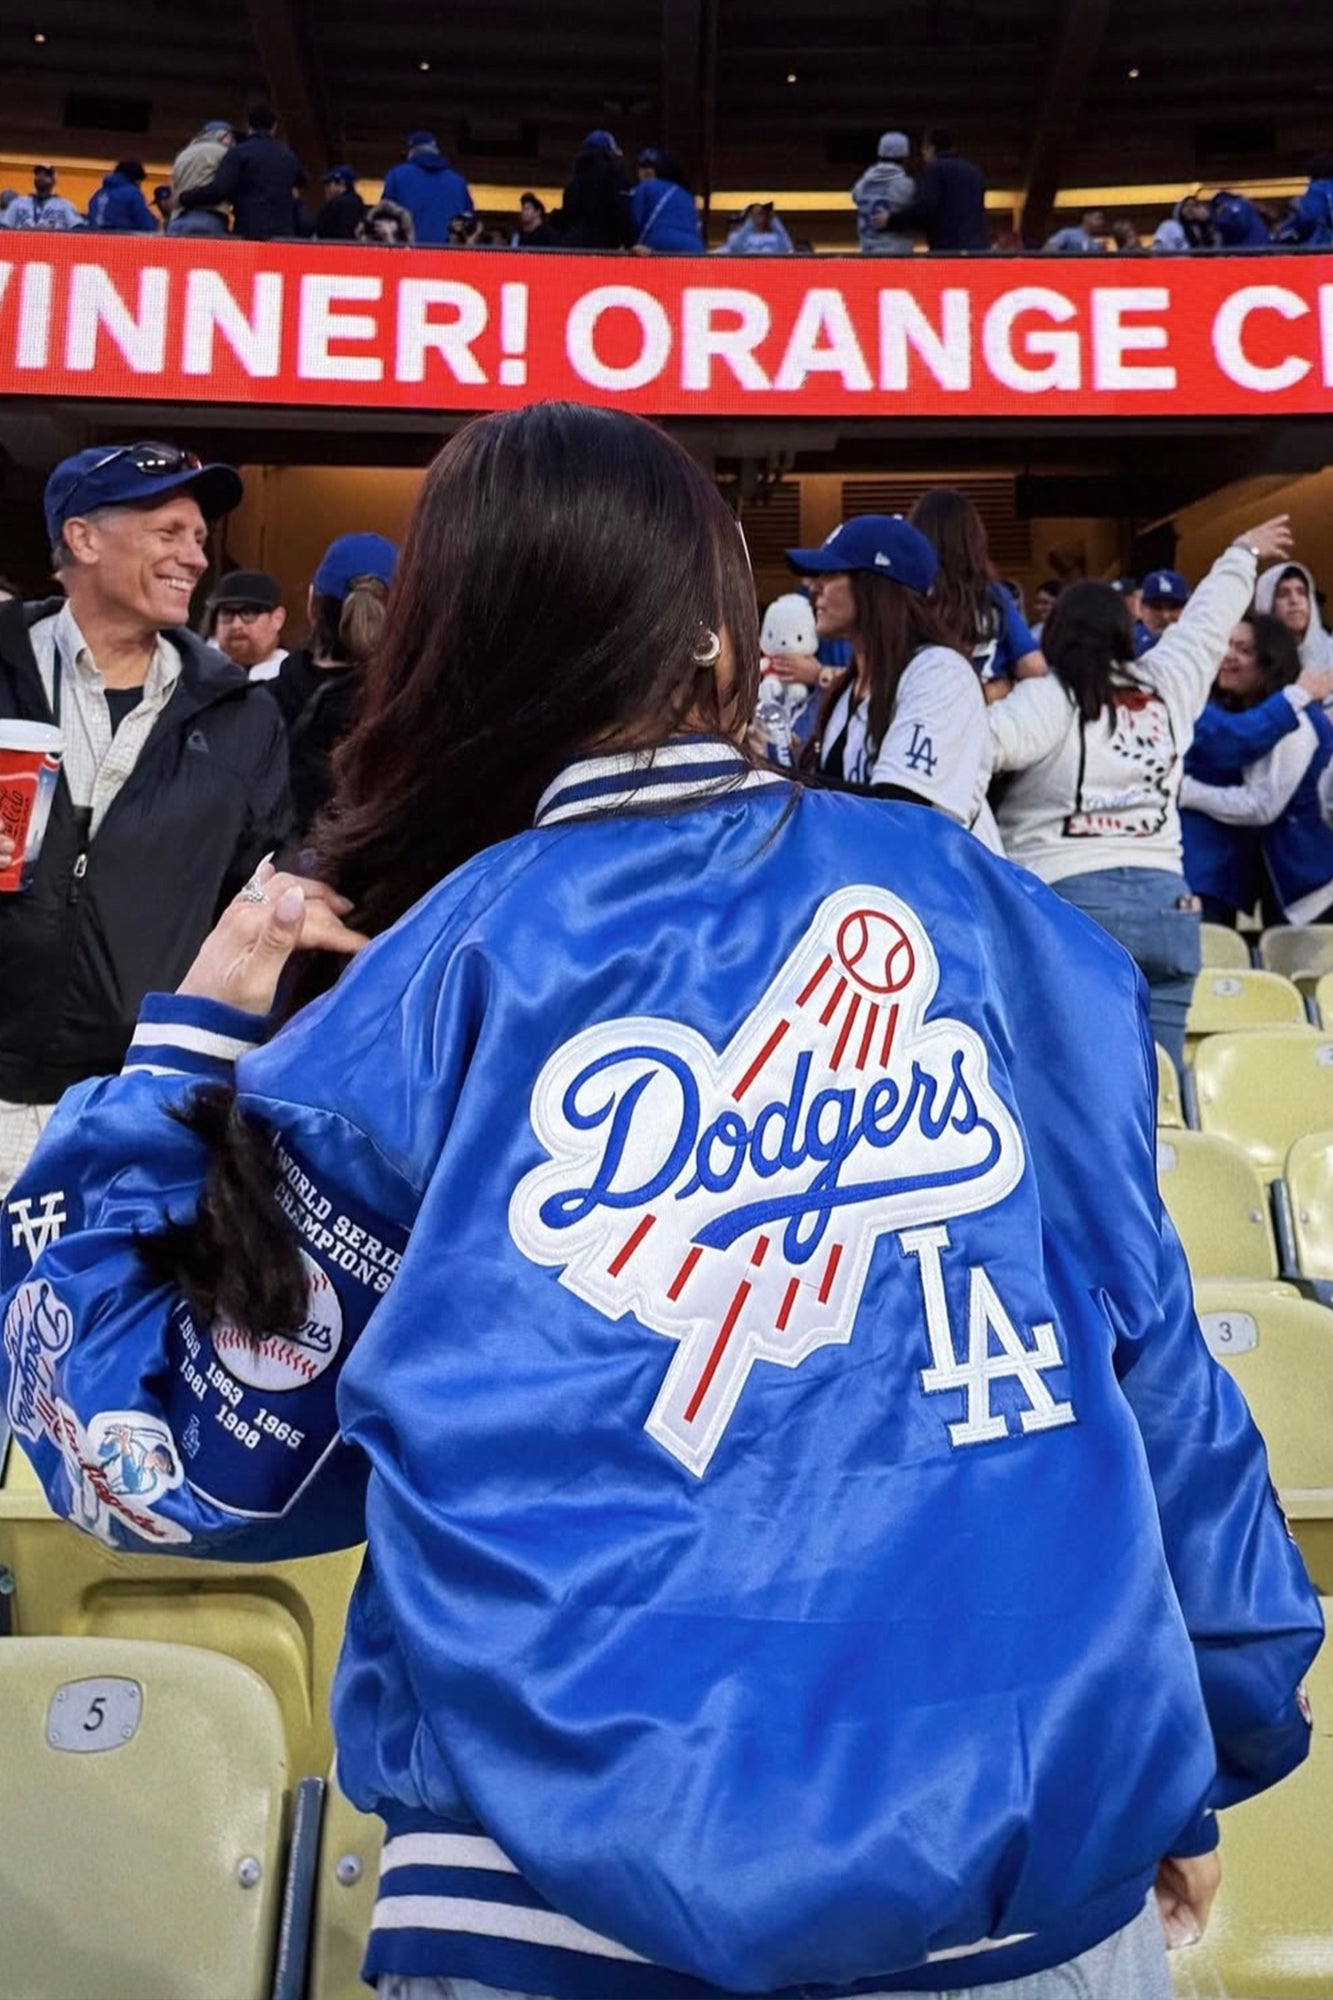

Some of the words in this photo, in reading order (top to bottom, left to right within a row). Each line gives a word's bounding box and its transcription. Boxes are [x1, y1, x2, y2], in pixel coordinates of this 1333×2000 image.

[0, 261, 528, 386] INNER!
[565, 284, 1177, 392] ORANGE
[905, 723, 938, 778] LA
[278, 1146, 333, 1221] WORLD
[539, 1045, 1002, 1265] Dodgers
[896, 1226, 1077, 1447] LA
[1219, 1321, 1232, 1343] 3
[179, 1356, 209, 1402] 1981
[214, 1404, 261, 1450] 1988
[206, 1361, 244, 1408] 1963
[253, 1408, 306, 1450] 1965
[83, 1697, 106, 1732] 5
